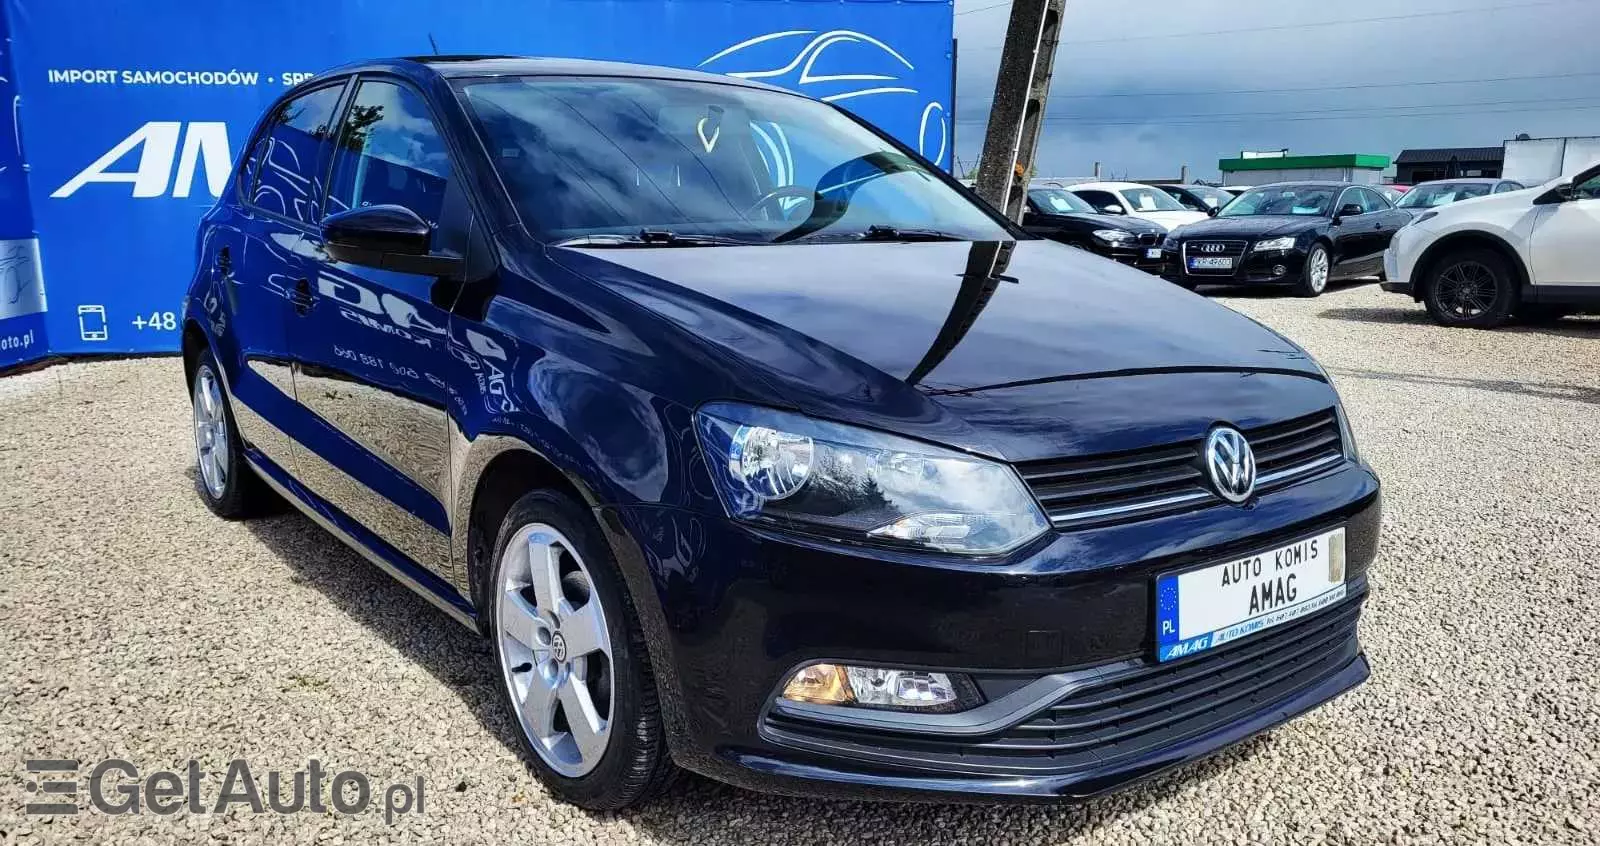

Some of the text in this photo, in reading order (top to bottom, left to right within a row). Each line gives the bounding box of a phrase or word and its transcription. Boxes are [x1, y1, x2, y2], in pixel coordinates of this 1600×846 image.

[48, 69, 118, 84] IMPORT
[122, 68, 259, 86] SAMOCHODÓW
[131, 311, 177, 331] +48
[1221, 540, 1319, 588] AUTO KOMIS
[1249, 573, 1298, 616] AMAG
[1162, 620, 1176, 636] PL
[1167, 636, 1208, 658] AMAG
